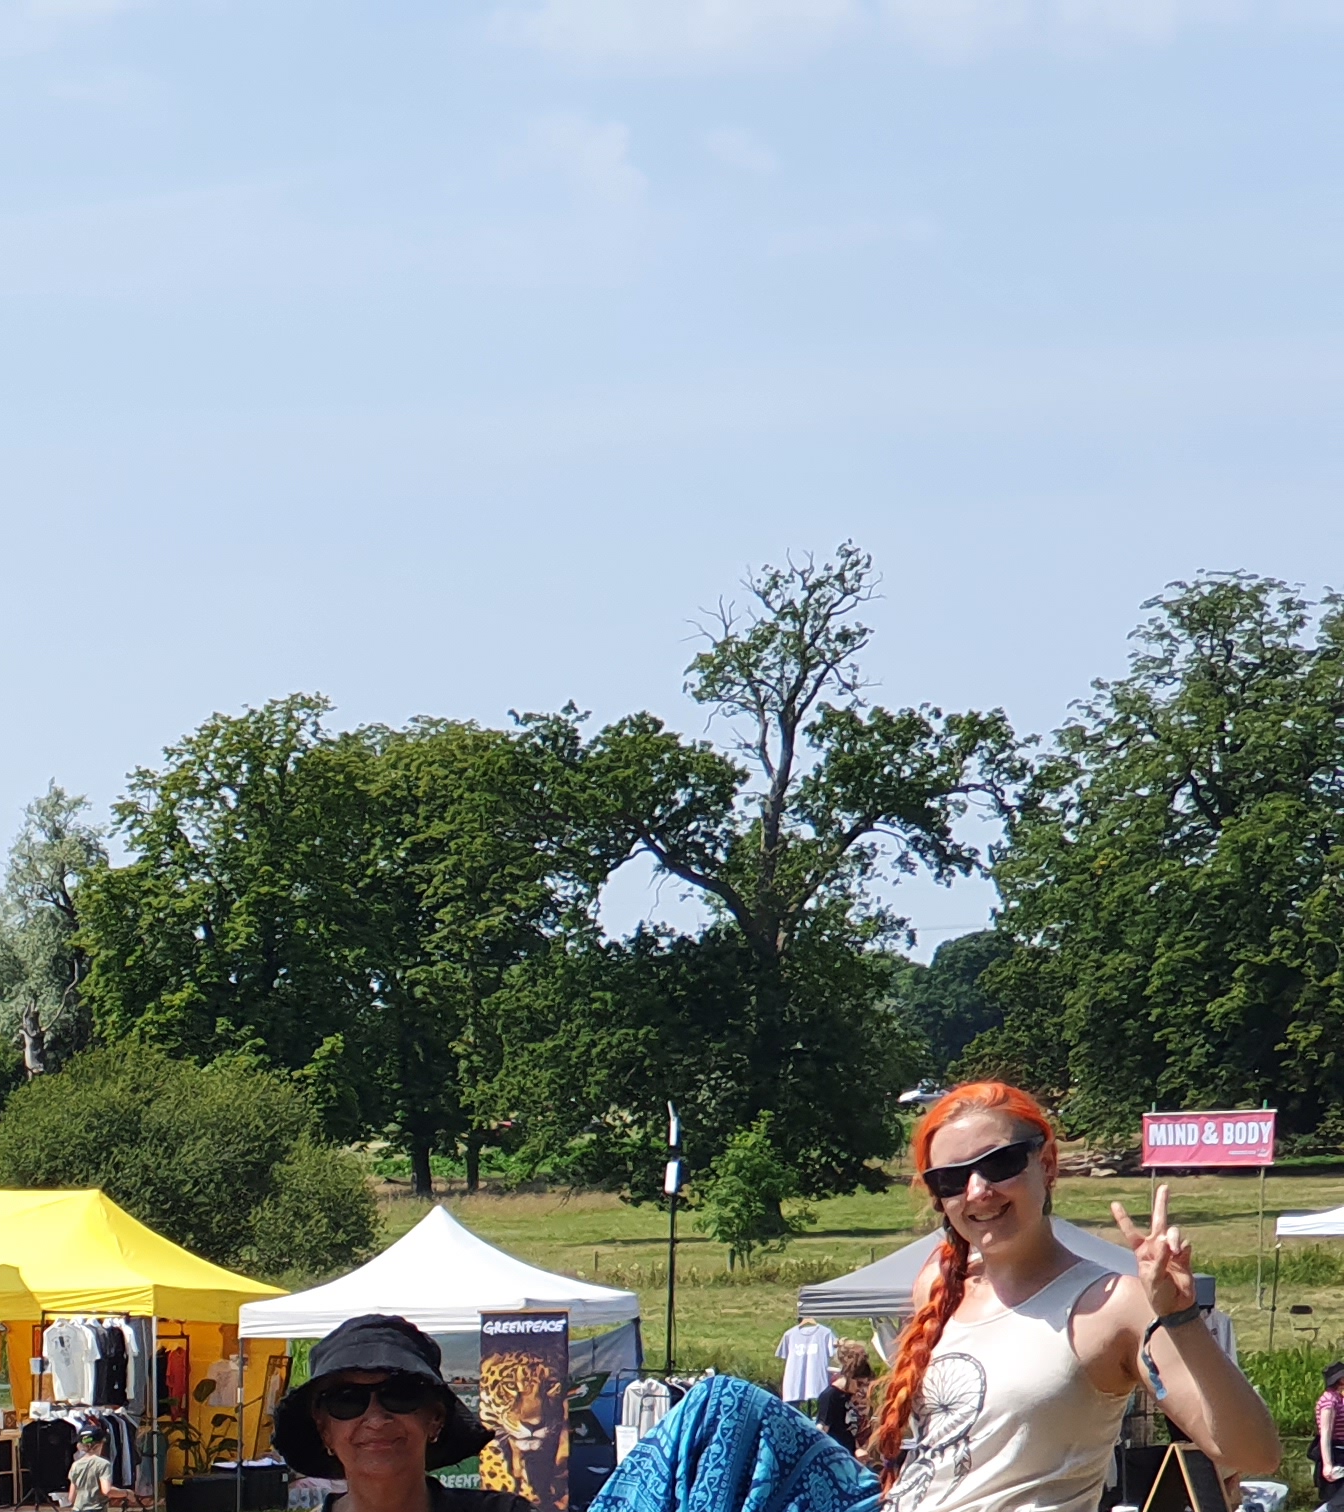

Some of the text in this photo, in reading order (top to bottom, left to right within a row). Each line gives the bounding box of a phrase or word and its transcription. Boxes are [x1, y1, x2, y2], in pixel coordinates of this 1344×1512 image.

[1148, 1121, 1272, 1146] MIND & BODY
[482, 1318, 566, 1335] GREENPEACE
